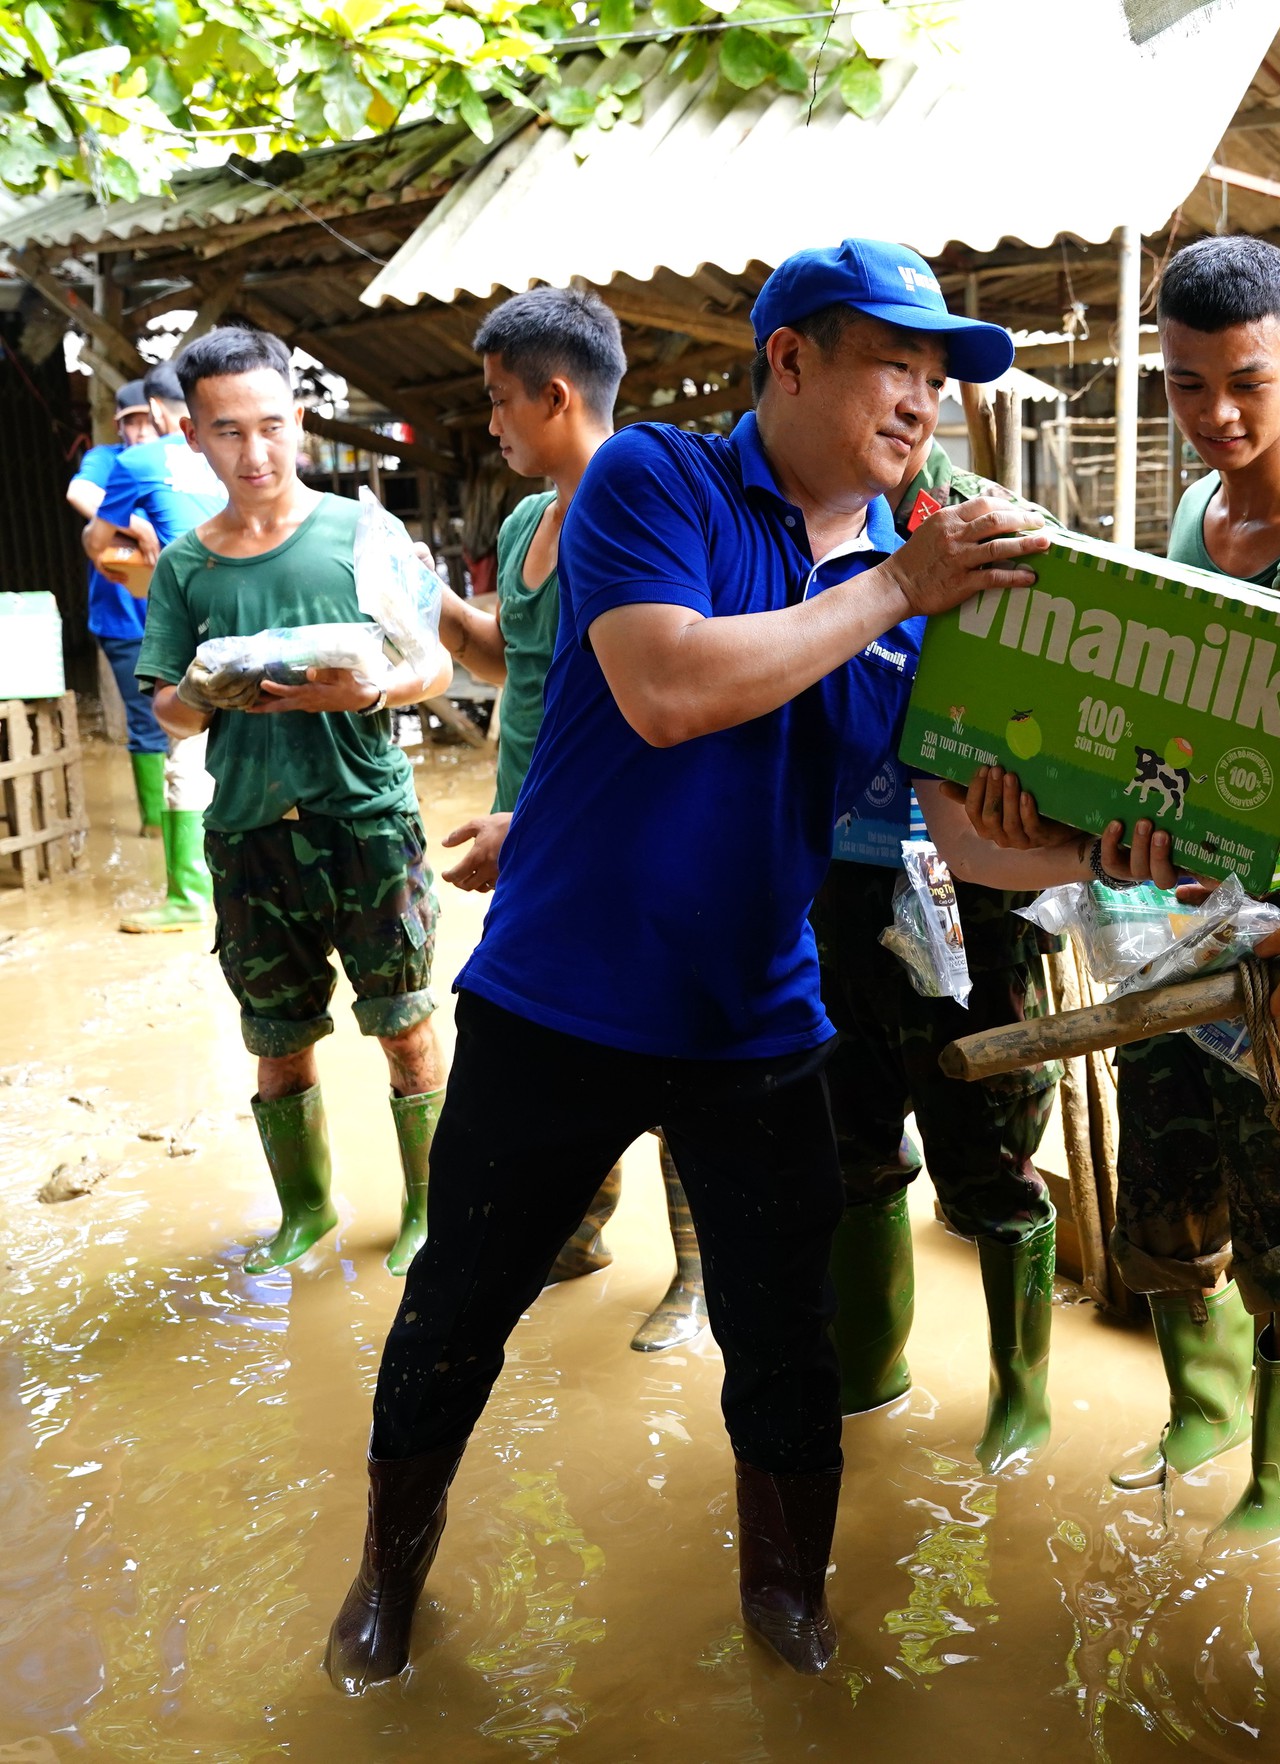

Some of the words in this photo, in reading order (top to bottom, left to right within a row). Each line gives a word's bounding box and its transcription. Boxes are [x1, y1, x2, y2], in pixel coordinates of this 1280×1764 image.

[866, 641, 907, 667] Vinamilk
[1184, 841, 1198, 857] (48
[1213, 855, 1221, 866] x
[1221, 855, 1237, 871] 180
[1236, 860, 1251, 878] ml)
